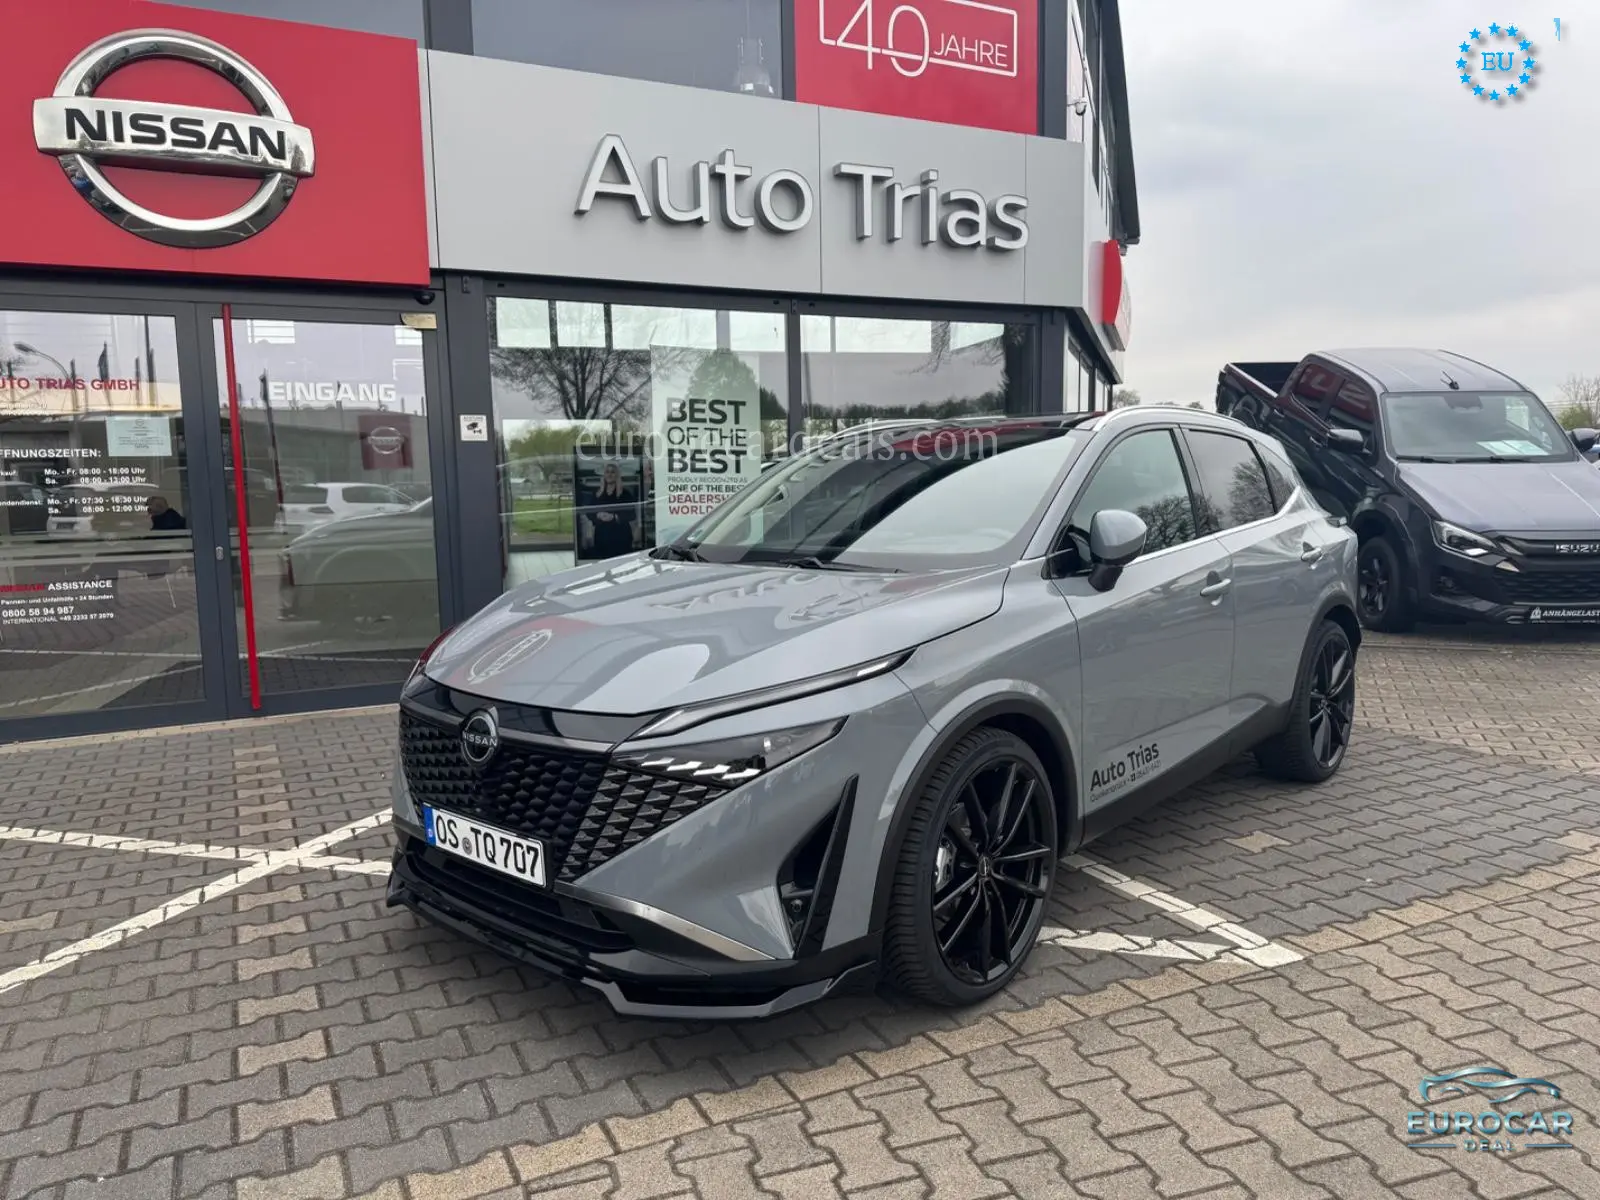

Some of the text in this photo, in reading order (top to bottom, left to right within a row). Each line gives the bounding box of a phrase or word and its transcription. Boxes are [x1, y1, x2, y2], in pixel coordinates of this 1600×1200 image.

[837, 0, 930, 77] 40
[934, 33, 1008, 67] JAHRE
[65, 107, 286, 160] NISSAN
[574, 133, 1029, 251] Auto Trias
[35, 377, 86, 390] TRIAS
[91, 379, 140, 391] GMBH
[268, 381, 397, 401] EINGANG
[667, 397, 747, 425] BEST
[667, 426, 748, 447] OF THE
[668, 448, 747, 474] BEST
[44, 468, 59, 476] Mo.
[66, 468, 77, 476] Fr.
[131, 466, 146, 474] Uhr
[131, 475, 146, 484] Uhr
[668, 484, 688, 493] ONE
[690, 484, 703, 493] OF
[705, 484, 723, 493] THE
[133, 495, 148, 503] Uhr
[134, 504, 149, 512] Uhr
[1555, 544, 1600, 553] ISUZU
[47, 580, 113, 591] ASSISTANCE
[2, 605, 74, 618] 0800 58 94 987
[463, 731, 498, 747] NISSAN
[1090, 761, 1126, 791] Auto
[1127, 743, 1160, 771] Trias
[436, 815, 539, 878] OS TQ 707
